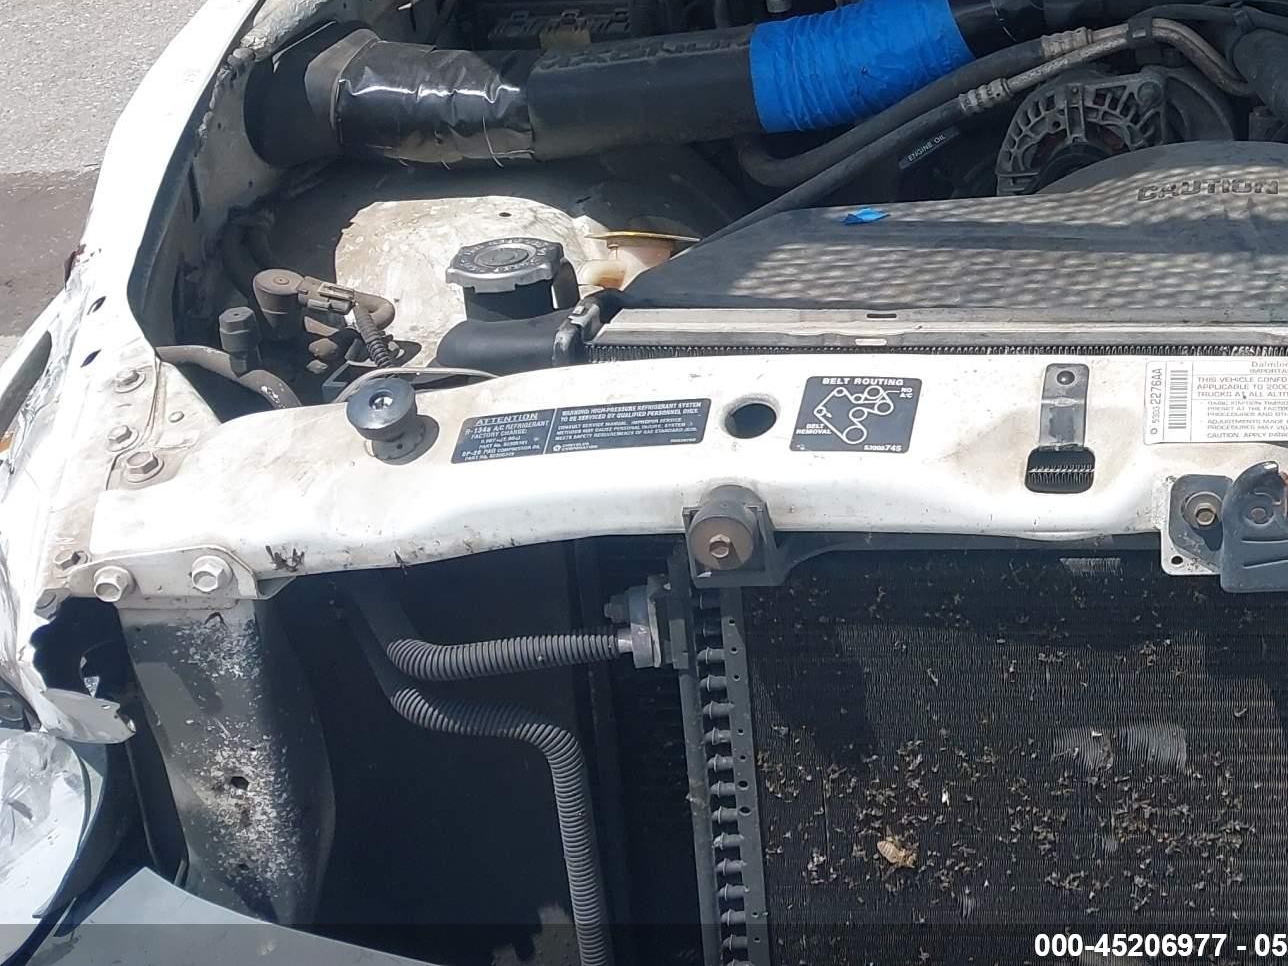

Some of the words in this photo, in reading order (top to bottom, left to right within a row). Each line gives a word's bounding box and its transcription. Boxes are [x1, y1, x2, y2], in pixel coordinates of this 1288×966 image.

[908, 141, 933, 162] ENGINE
[934, 134, 946, 144] OIL
[1137, 178, 1279, 201] CAUTION
[822, 377, 850, 385] BELT
[591, 406, 637, 415] HIGH-PRESSURE
[637, 403, 677, 411] REFRIGERANT
[678, 401, 702, 409] SYSTEM
[475, 413, 538, 425] ATTENTION
[577, 414, 607, 422] SERVICED
[616, 411, 646, 419] QUALIFIED
[647, 409, 682, 417] PERSONNEL
[505, 420, 550, 431] REFRIGERANT
